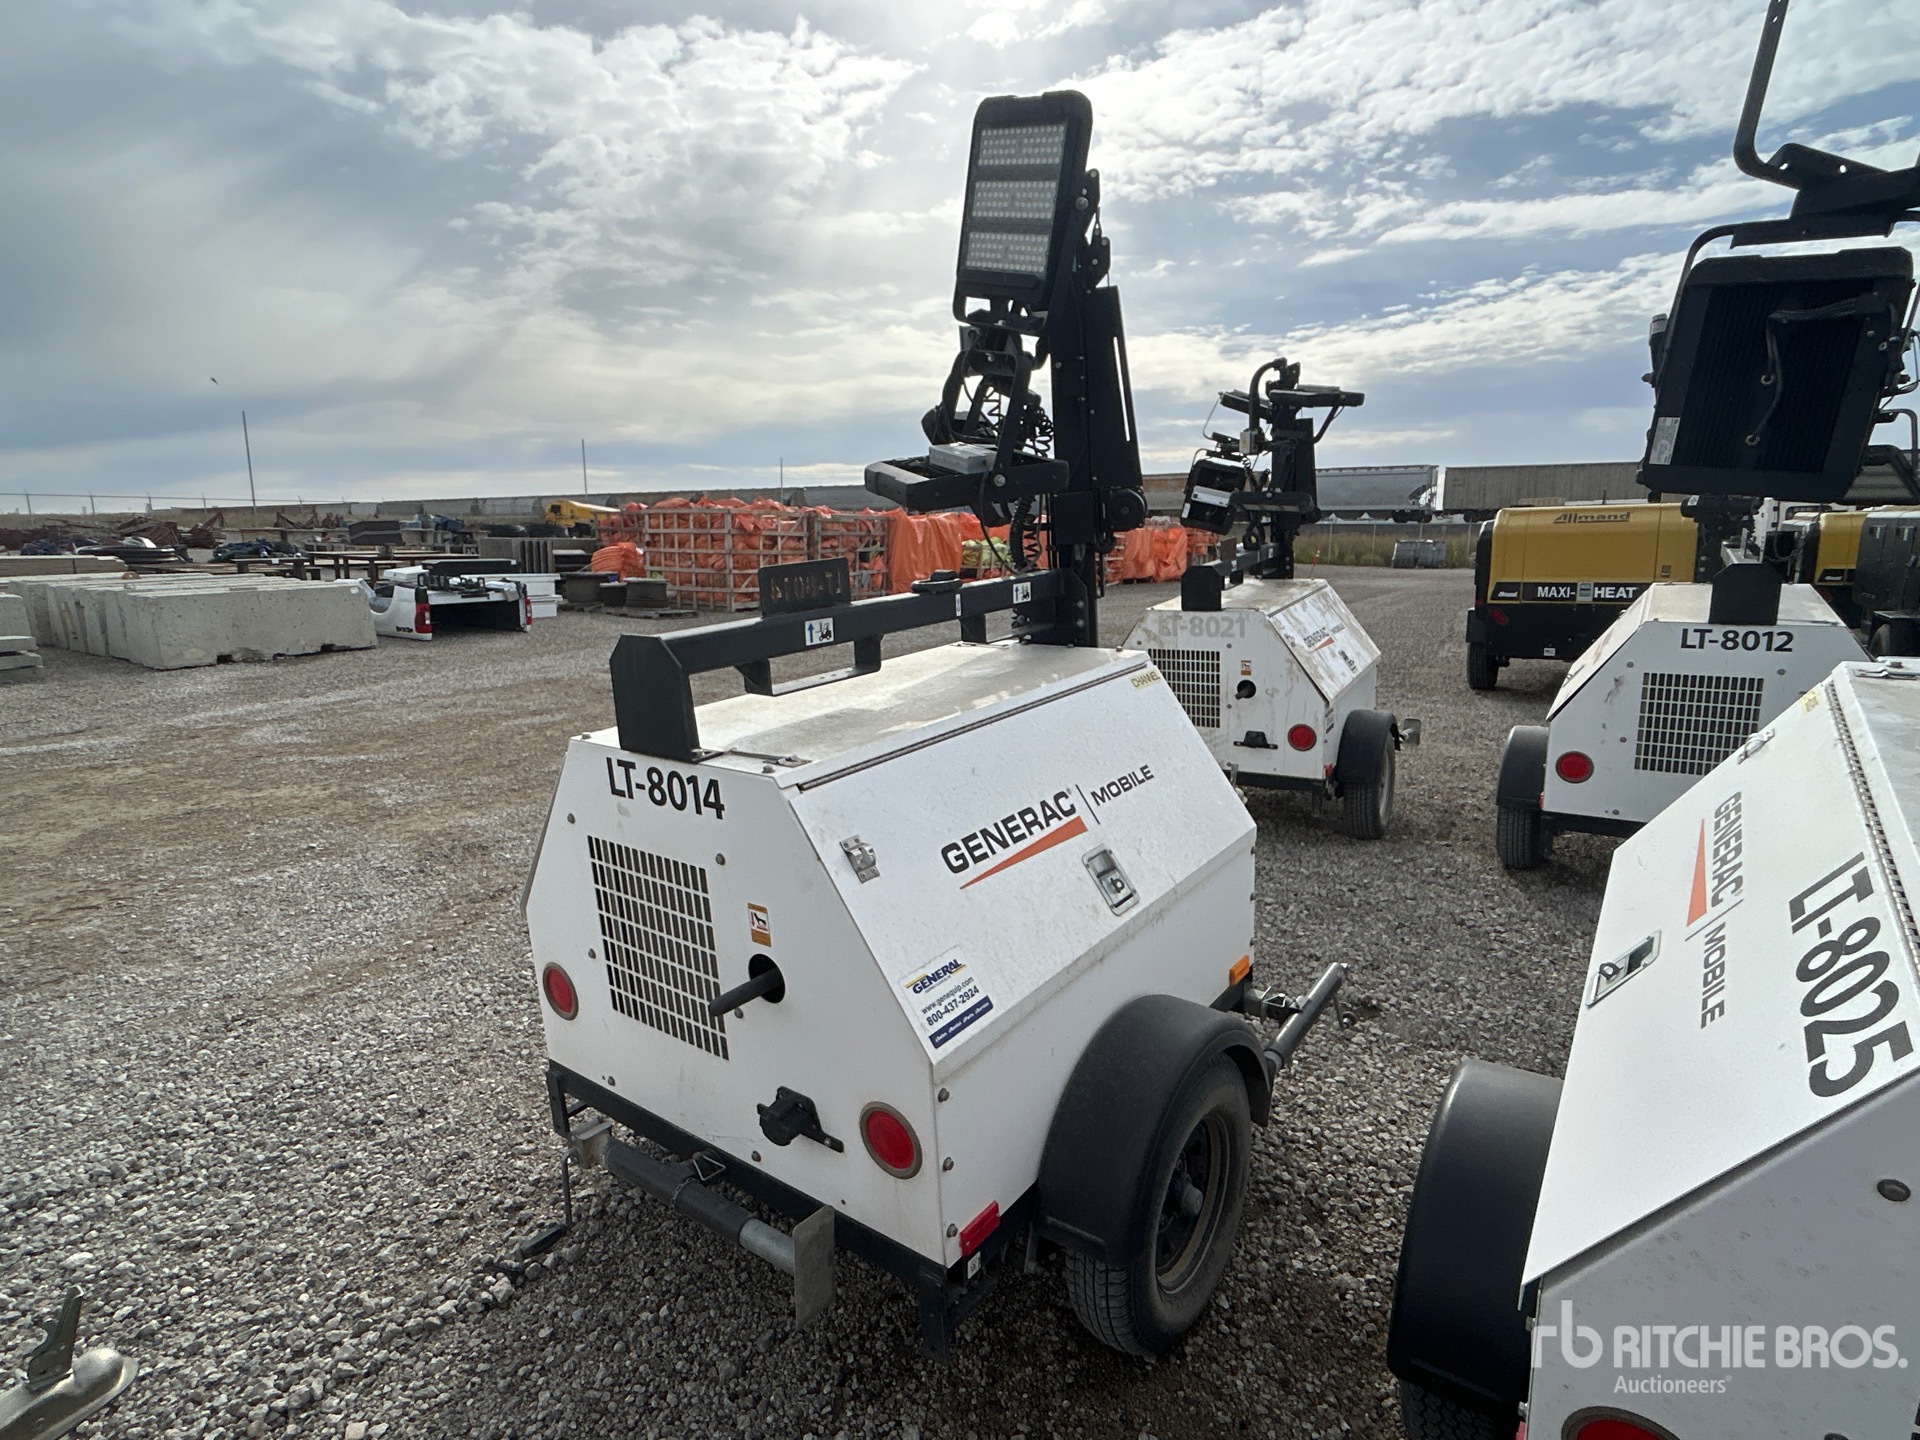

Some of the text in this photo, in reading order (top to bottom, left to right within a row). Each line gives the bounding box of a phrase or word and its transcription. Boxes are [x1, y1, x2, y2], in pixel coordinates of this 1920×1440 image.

[1554, 511, 1632, 524] Allmand
[1594, 586, 1637, 599] HEAT
[1157, 613, 1246, 638] LT-8021
[1680, 628, 1794, 653] LT-8012
[606, 757, 725, 819] LT-8014
[941, 764, 1155, 875] GENERAC MOBILE
[1701, 791, 1744, 1030] GENERAC MOBILE
[912, 958, 963, 995] GENERAL
[1788, 852, 1914, 1099] LT-8025
[926, 985, 979, 1026] 800-437-2924
